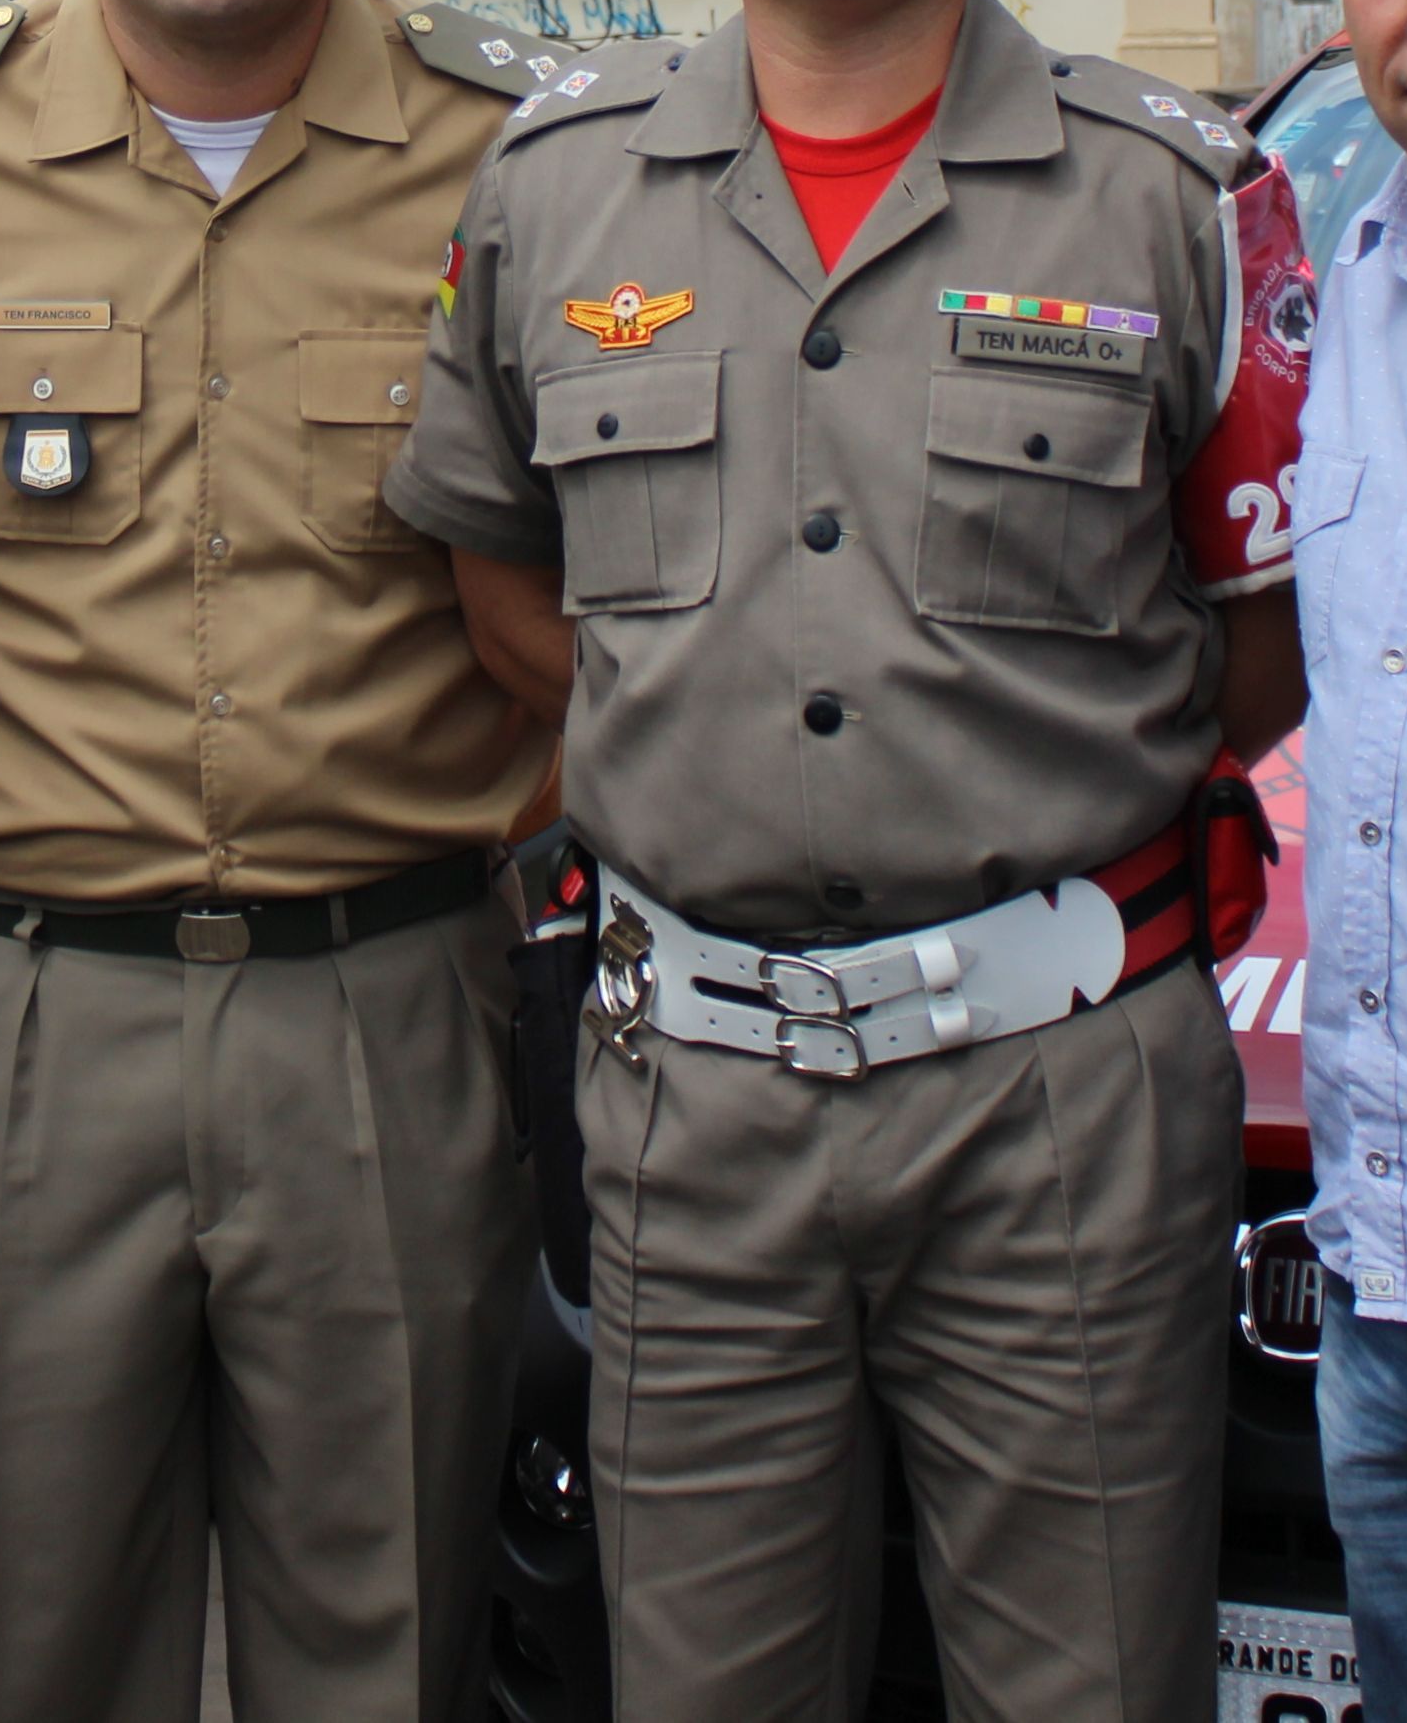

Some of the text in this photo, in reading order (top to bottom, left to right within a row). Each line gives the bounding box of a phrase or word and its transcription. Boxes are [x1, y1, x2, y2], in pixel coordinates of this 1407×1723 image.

[3, 310, 92, 319] TEN FRANCISCO
[977, 330, 1014, 351] TEN
[1022, 328, 1089, 359] MAICÁ
[1254, 343, 1297, 384] CORPO
